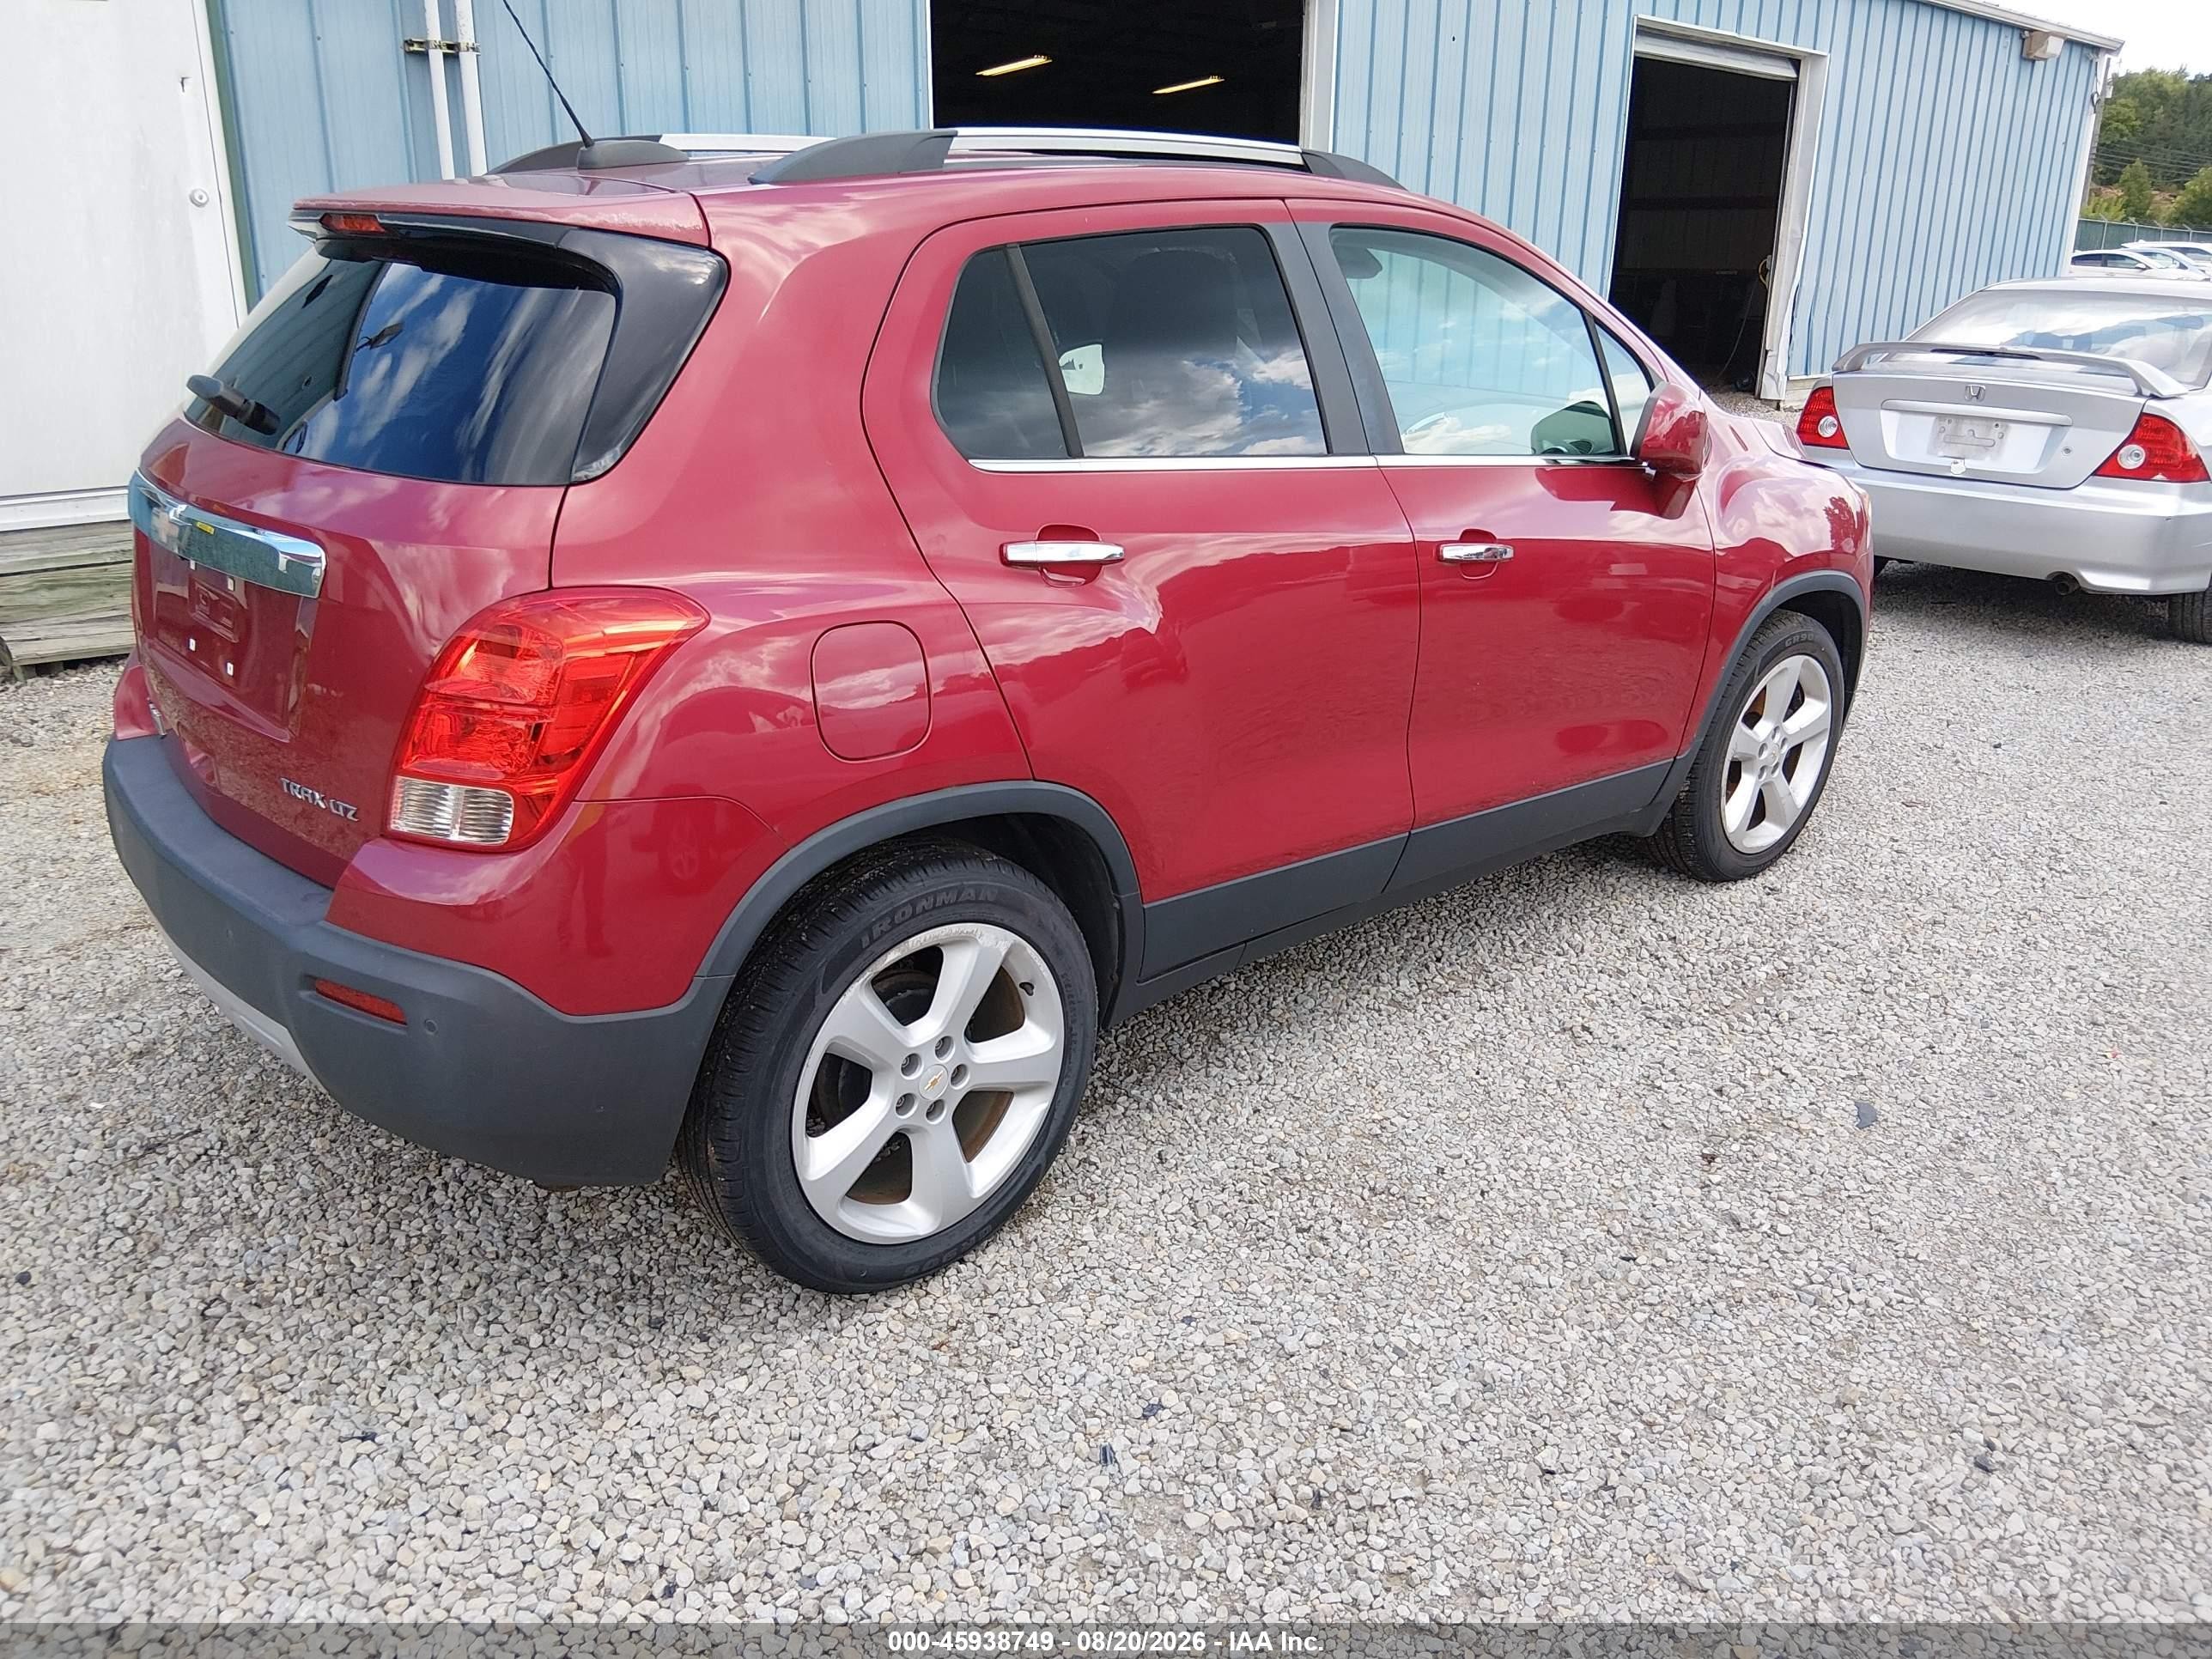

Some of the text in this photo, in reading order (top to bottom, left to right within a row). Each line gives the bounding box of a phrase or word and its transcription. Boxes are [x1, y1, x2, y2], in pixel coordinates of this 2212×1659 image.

[280, 777, 360, 822] TRAX LTZ
[860, 885, 1000, 948] IRONMAN
